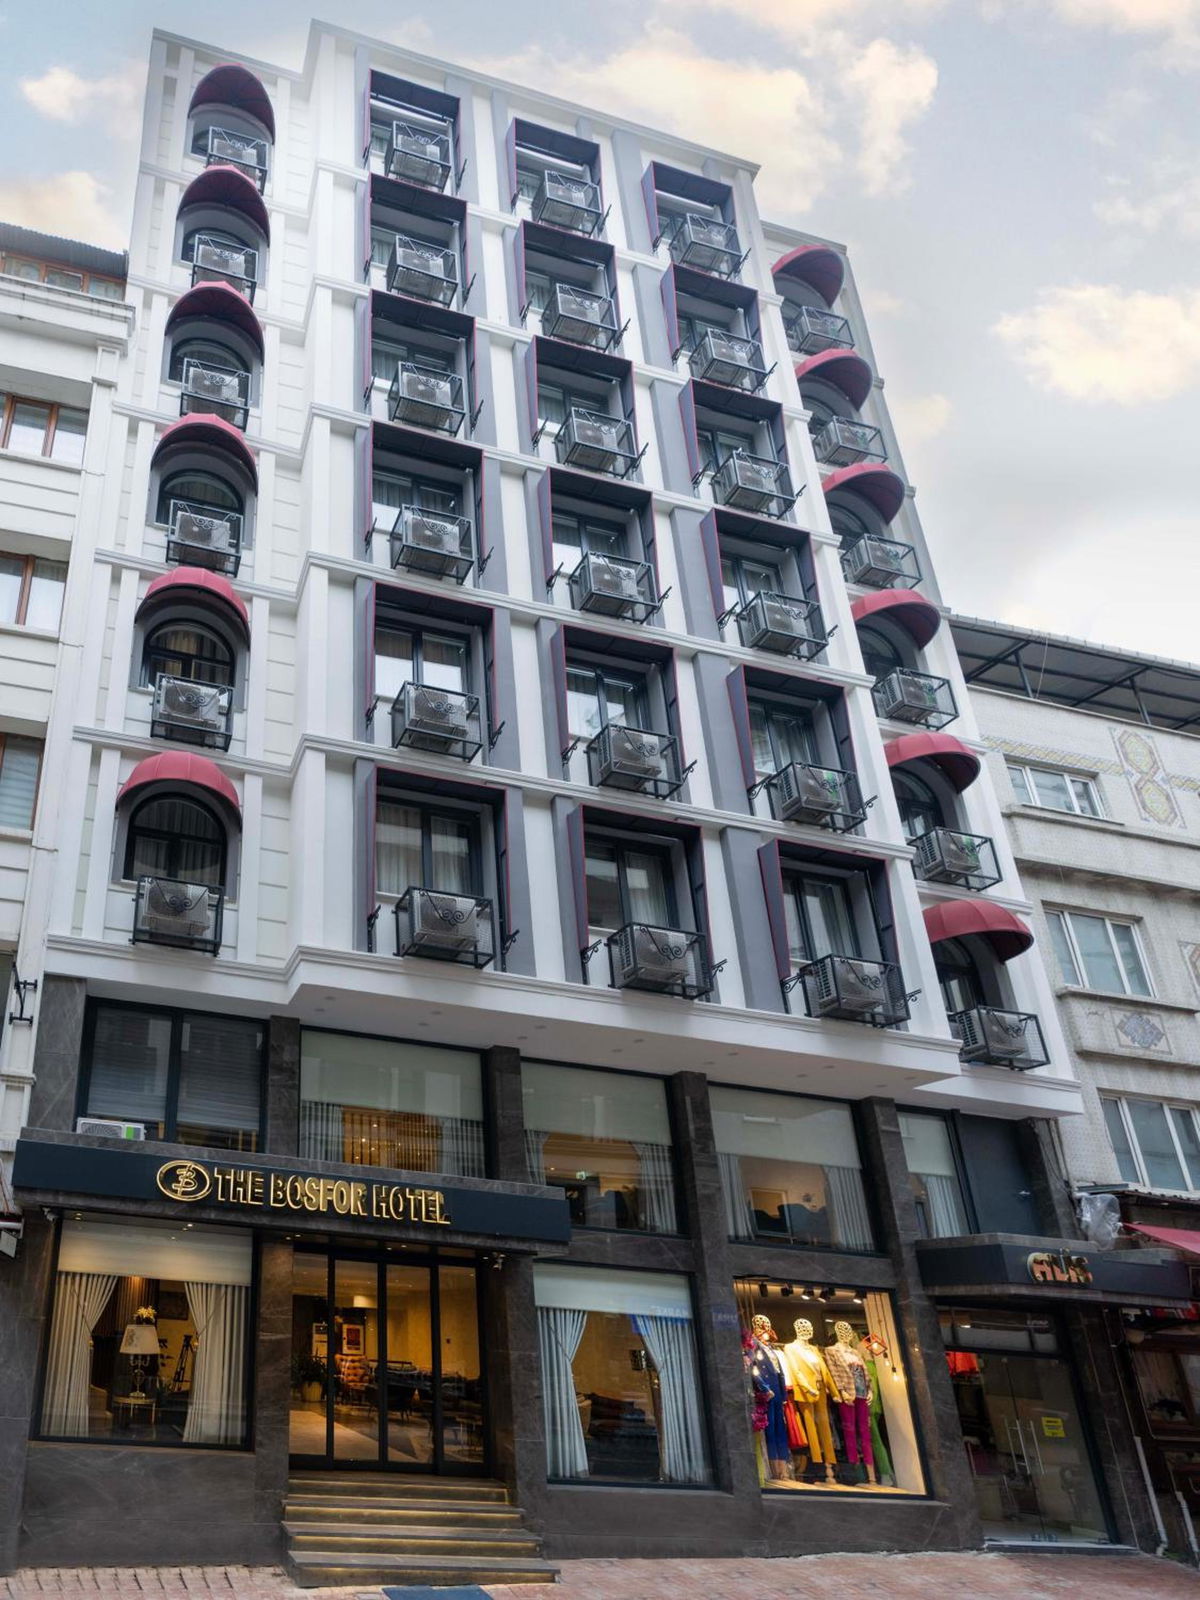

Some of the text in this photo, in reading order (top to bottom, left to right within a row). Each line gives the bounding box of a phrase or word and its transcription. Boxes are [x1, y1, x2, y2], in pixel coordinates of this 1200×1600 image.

[214, 1167, 451, 1225] THE BOSFOR HOTEL
